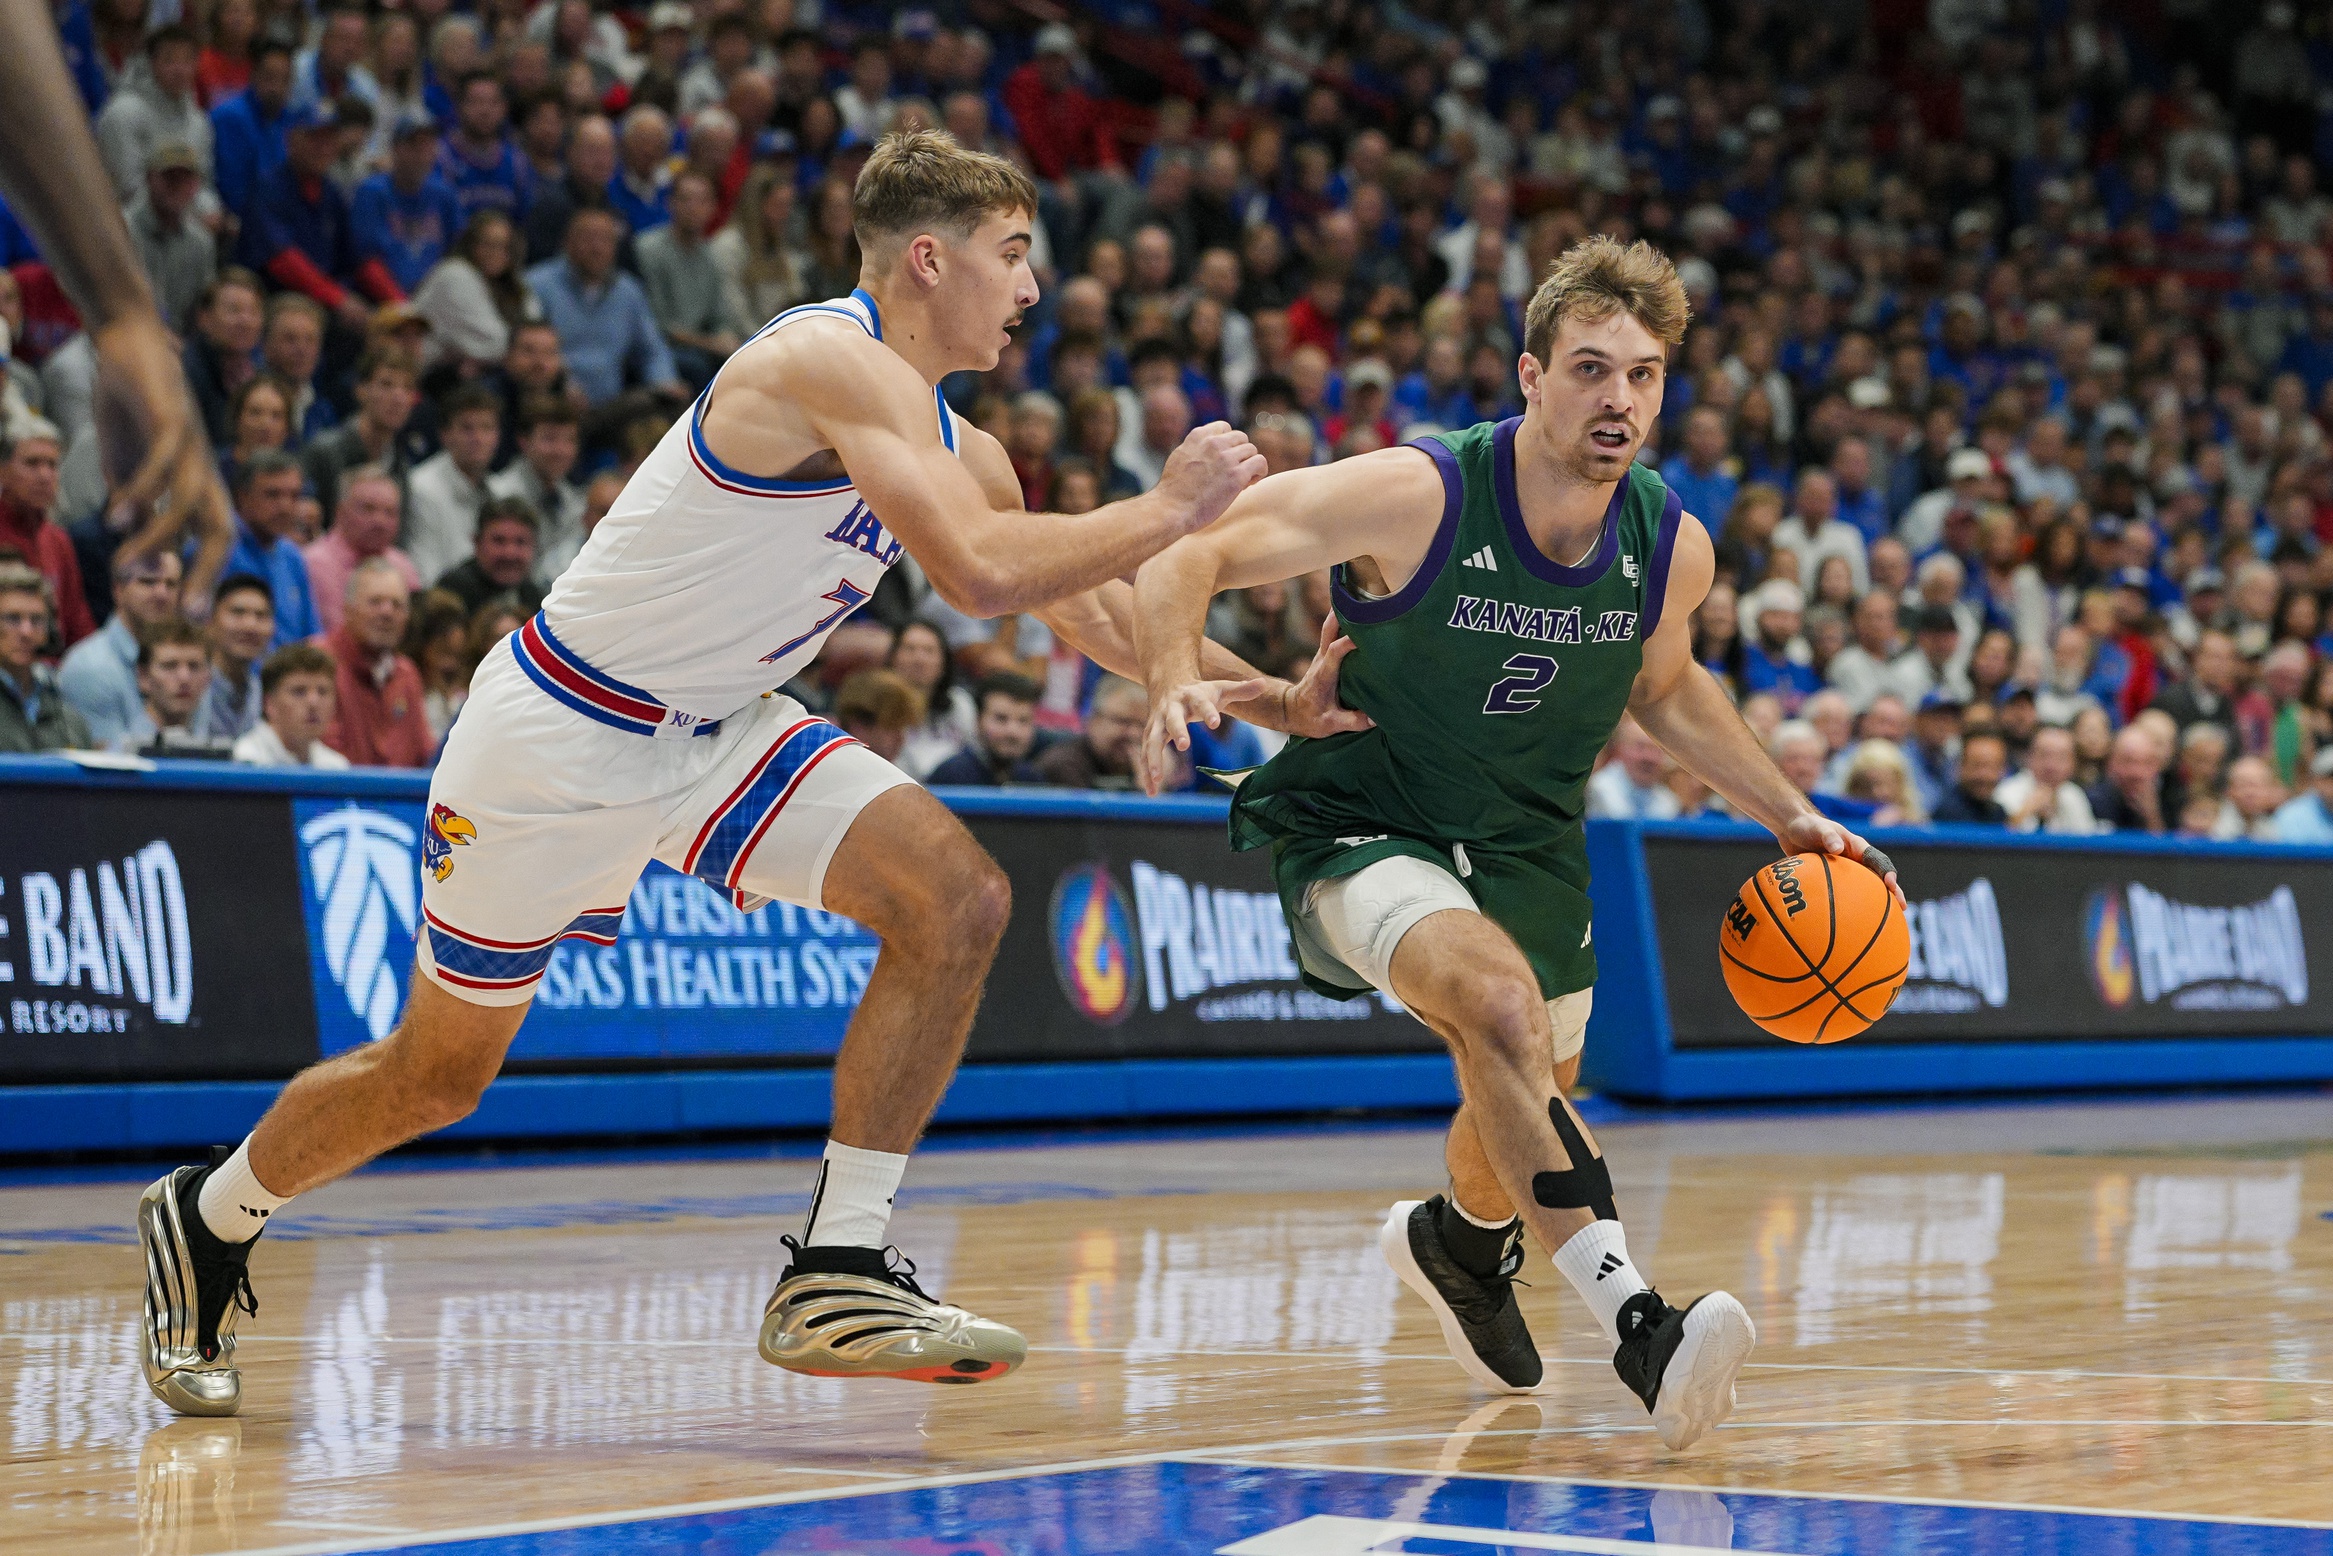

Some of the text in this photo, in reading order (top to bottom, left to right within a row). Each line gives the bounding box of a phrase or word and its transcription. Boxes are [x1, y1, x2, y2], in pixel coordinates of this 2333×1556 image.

[1483, 653, 1559, 714] 2
[668, 710, 697, 727] KU
[21, 837, 194, 1024] BAND
[1727, 893, 1758, 942] CAA
[627, 938, 798, 1008] HEALTH
[801, 940, 881, 1008] SYS
